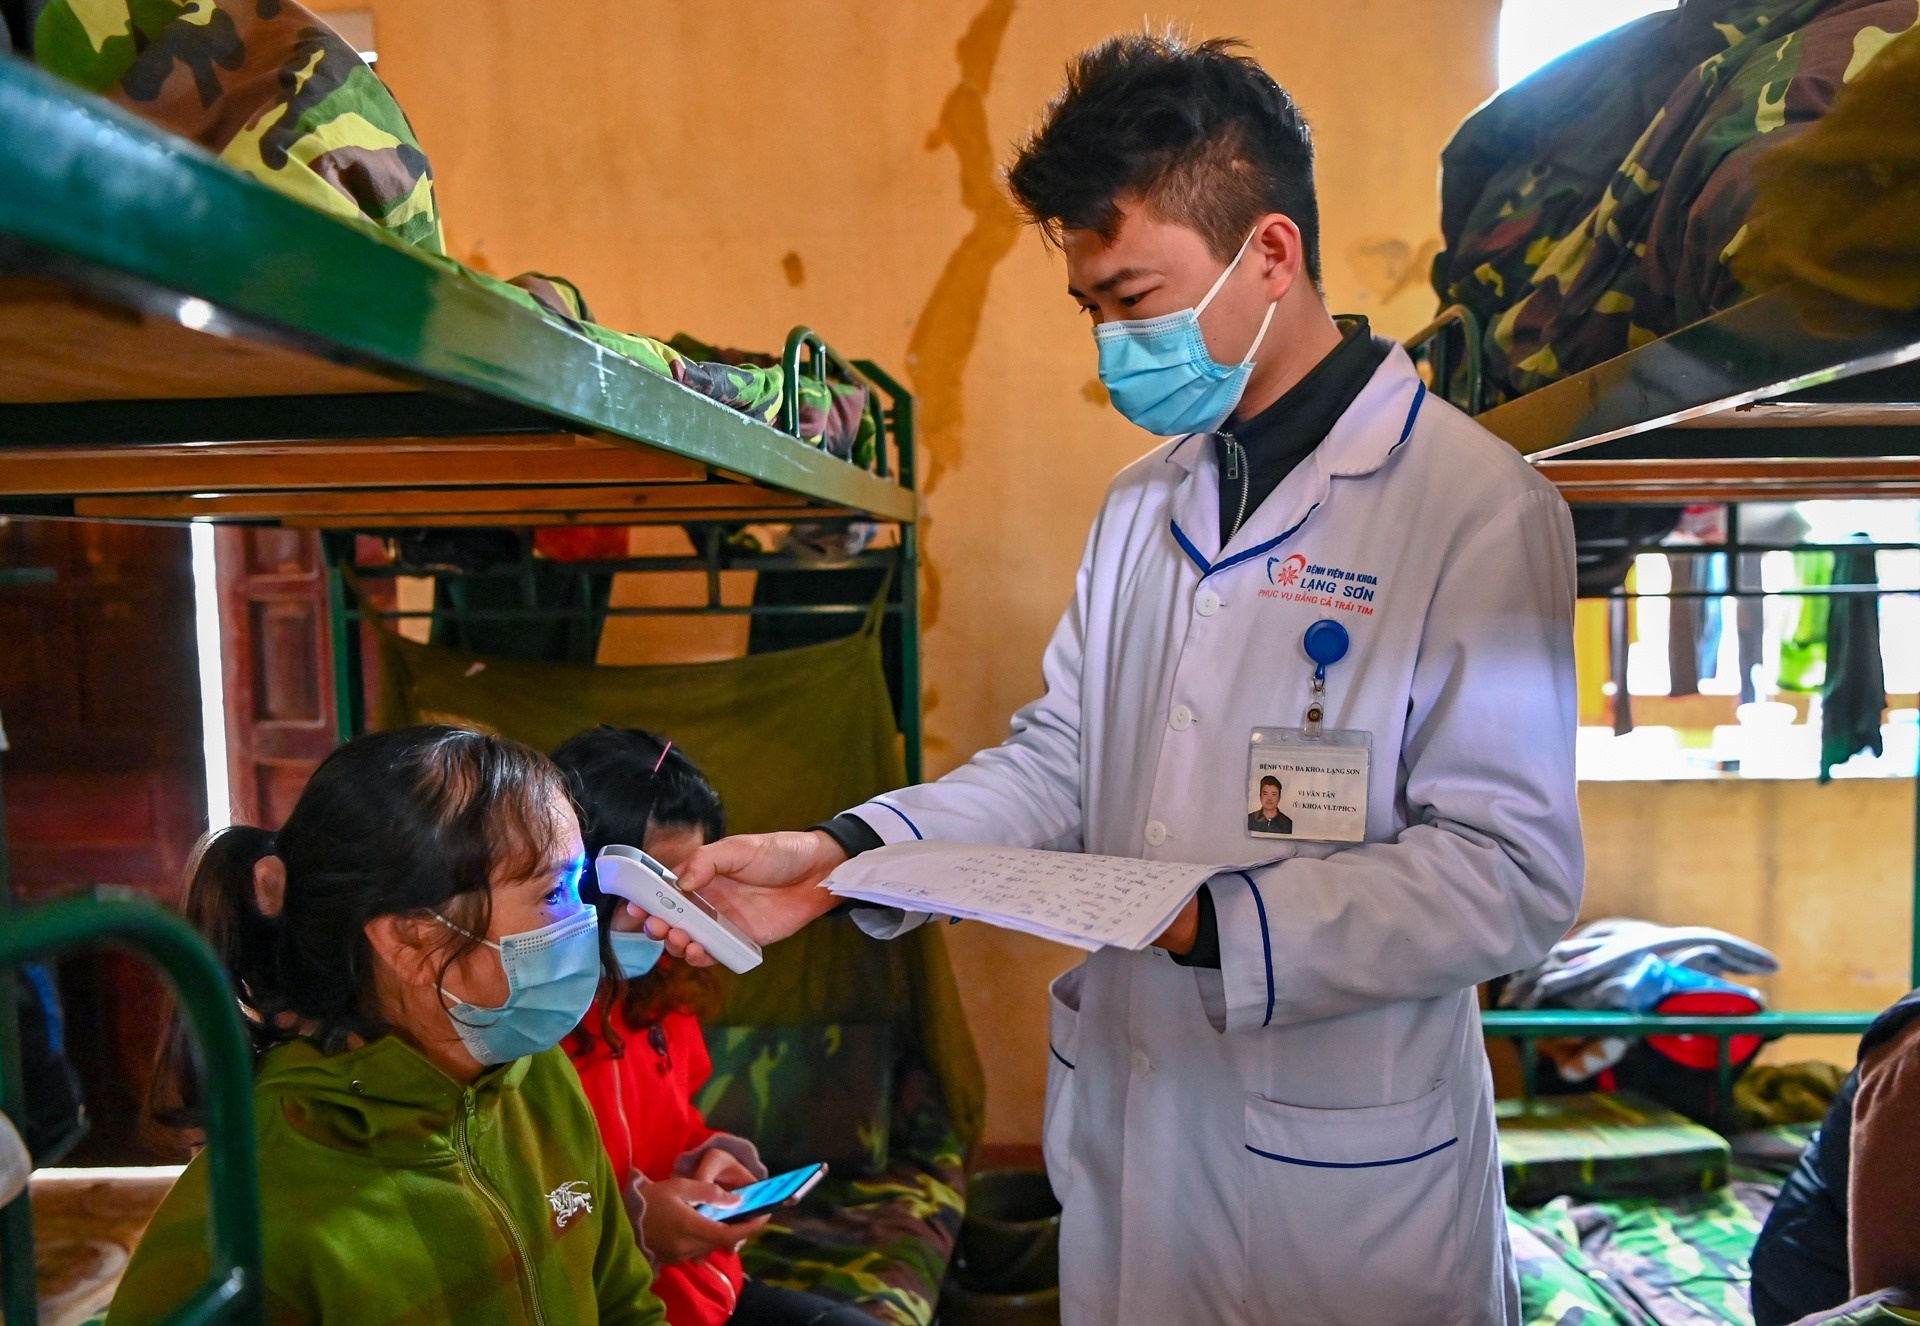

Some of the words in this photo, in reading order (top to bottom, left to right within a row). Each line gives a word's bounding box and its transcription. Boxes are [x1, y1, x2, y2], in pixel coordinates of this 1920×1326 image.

[1306, 564, 1326, 575] BỆNH
[1327, 568, 1344, 579] VIỆN
[1357, 574, 1377, 585] KHOA
[1300, 578, 1336, 593] LẠNG
[1342, 586, 1374, 602] SƠN
[1258, 590, 1278, 598] PHỤC
[1281, 592, 1293, 601] VỤ
[1335, 601, 1354, 611] TRÁI
[1357, 605, 1373, 615] TIM
